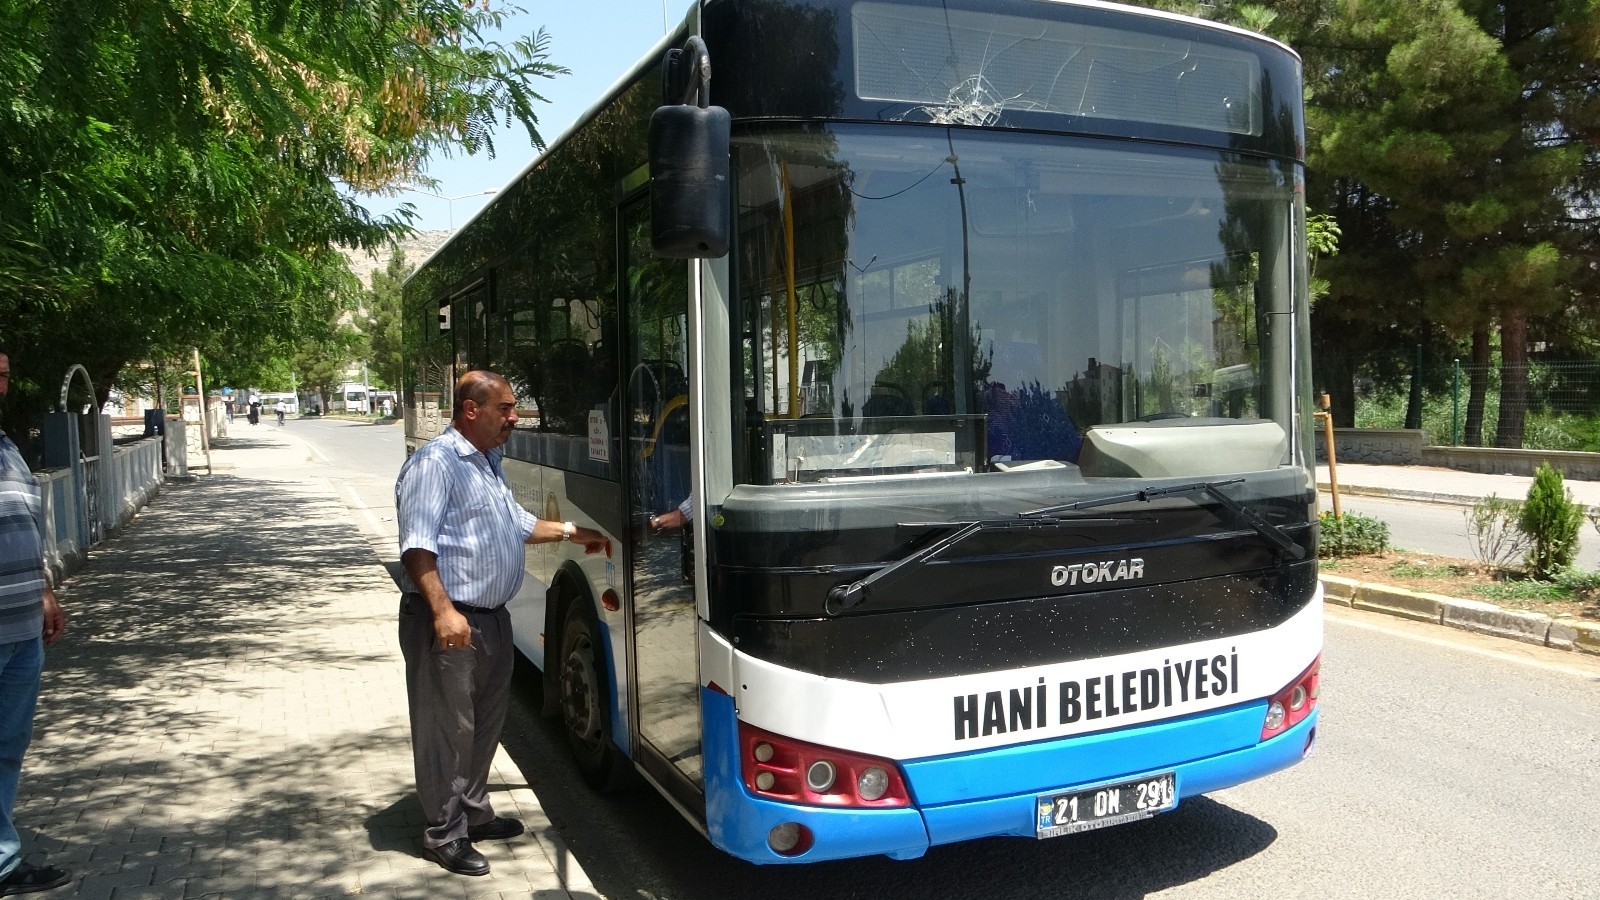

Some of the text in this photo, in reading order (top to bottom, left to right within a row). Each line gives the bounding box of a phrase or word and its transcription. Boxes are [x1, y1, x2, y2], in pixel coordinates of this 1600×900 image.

[1051, 558, 1144, 587] OTOKAR
[954, 646, 1238, 740] HANİ BELEDİYESİ
[1041, 815, 1051, 824] TR
[1055, 796, 1078, 825] 21
